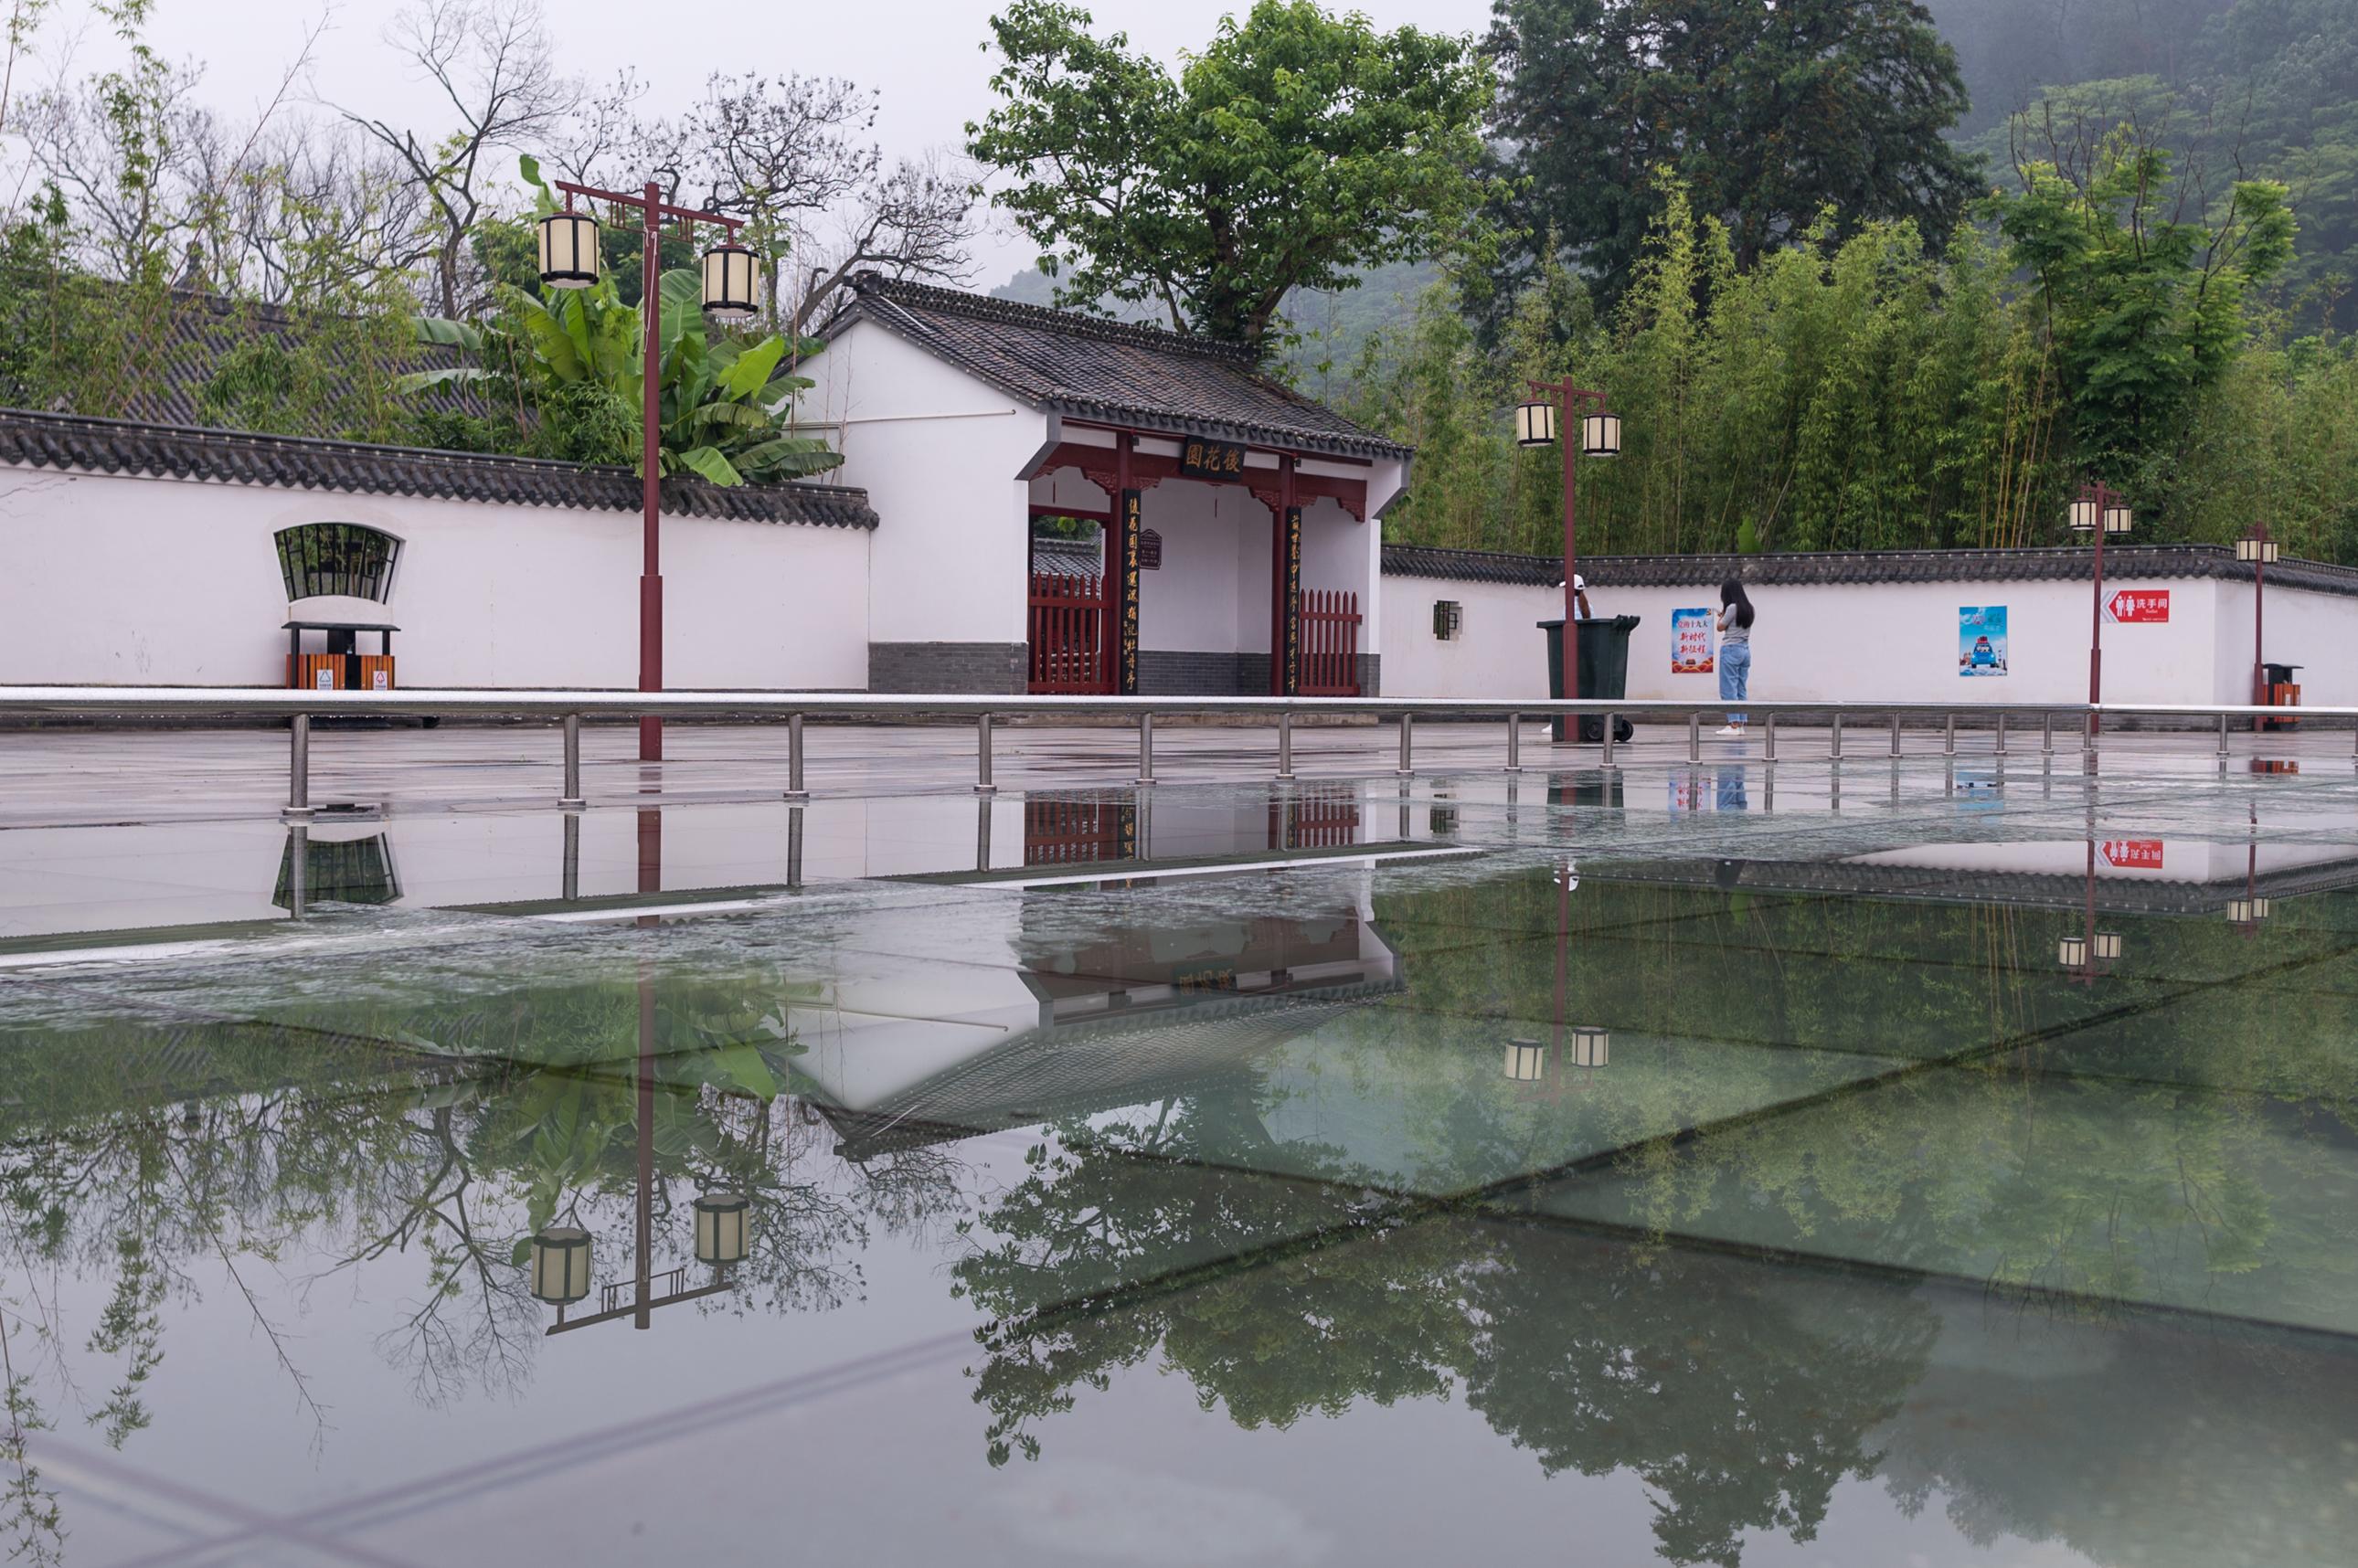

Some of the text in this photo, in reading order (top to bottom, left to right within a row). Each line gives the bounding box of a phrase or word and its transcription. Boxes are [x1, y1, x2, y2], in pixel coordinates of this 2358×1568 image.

[1185, 443, 1240, 472] 後花園
[2137, 599, 2167, 609] 洗手间
[1680, 631, 1705, 641] 新时代
